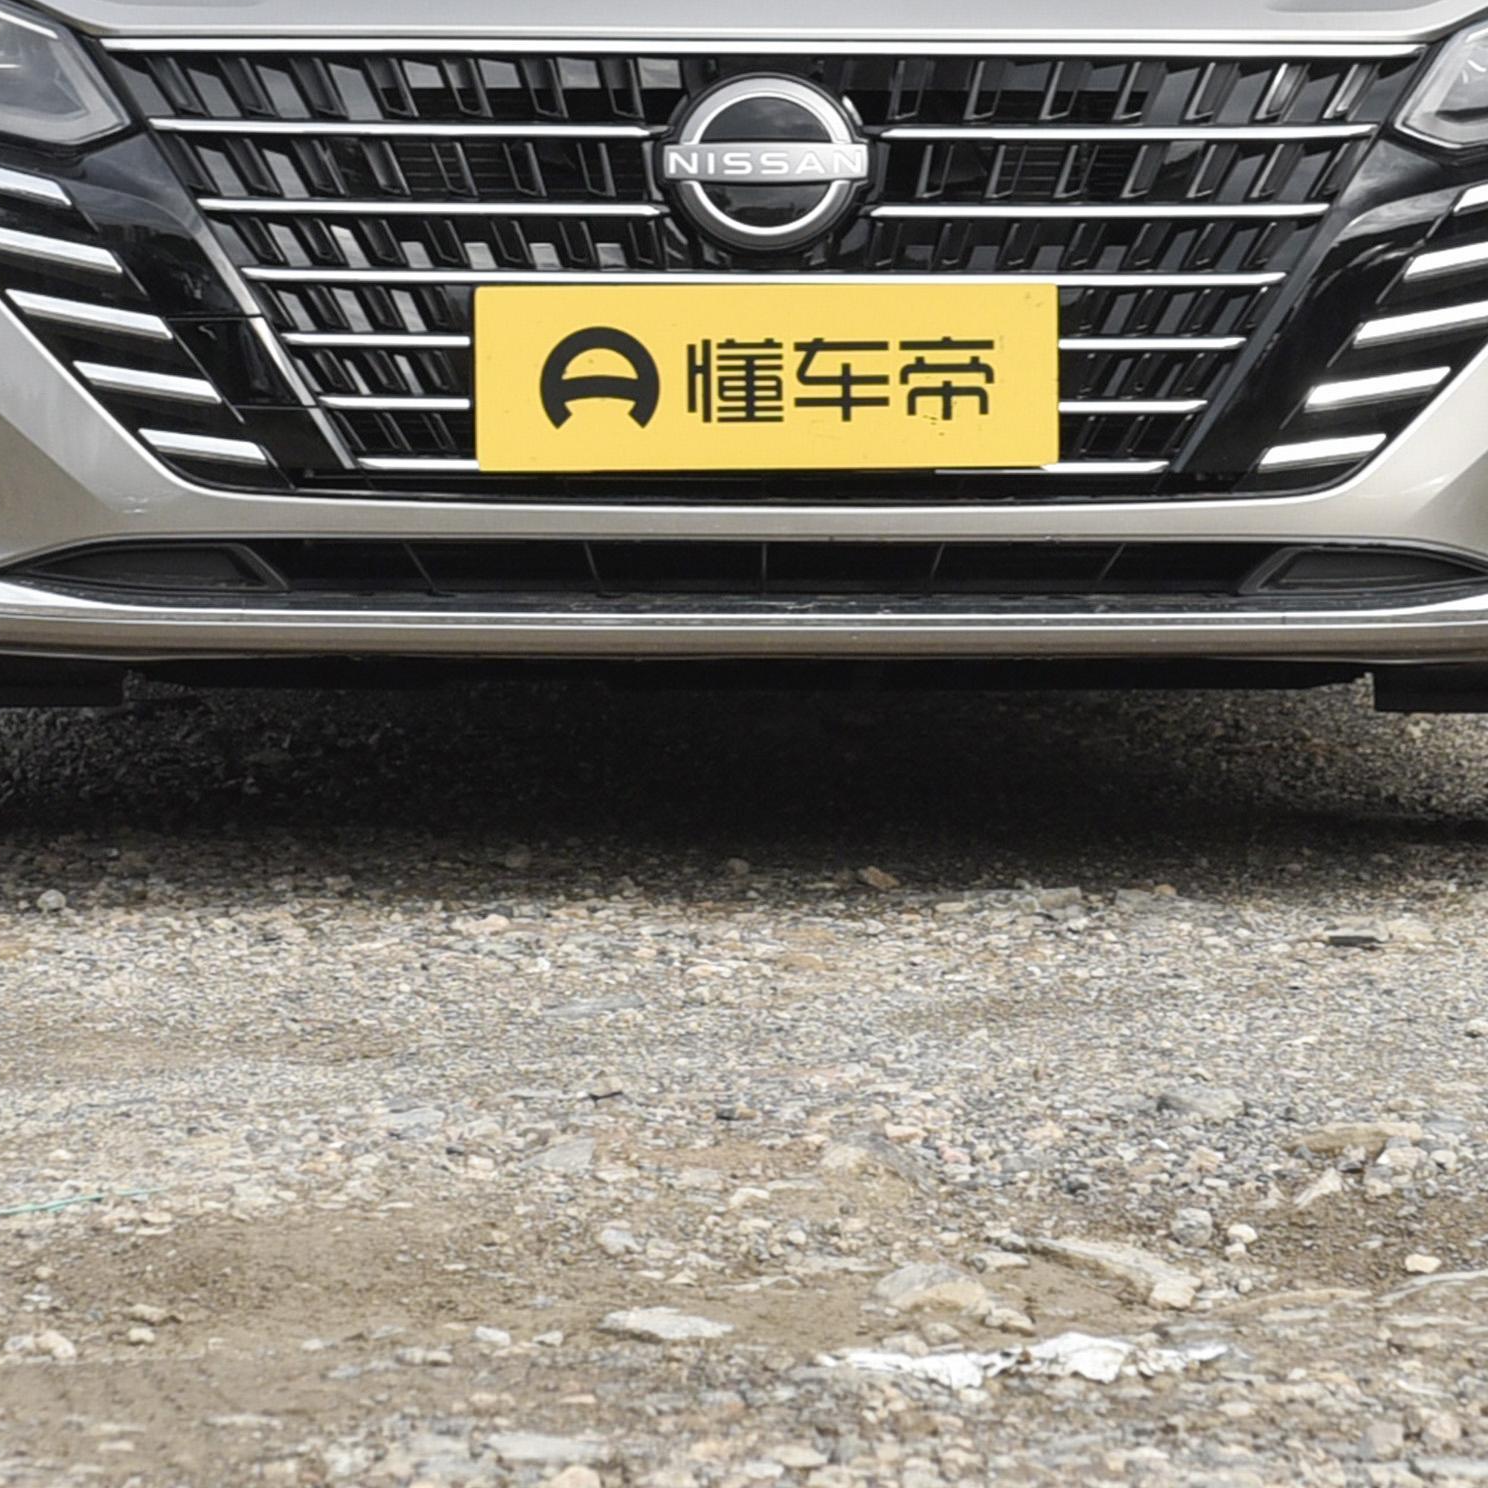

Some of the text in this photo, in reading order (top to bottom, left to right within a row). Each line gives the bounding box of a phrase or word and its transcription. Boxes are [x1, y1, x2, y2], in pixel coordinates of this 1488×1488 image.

[668, 152, 863, 175] NISSAN
[686, 336, 994, 423] 懂车帝
